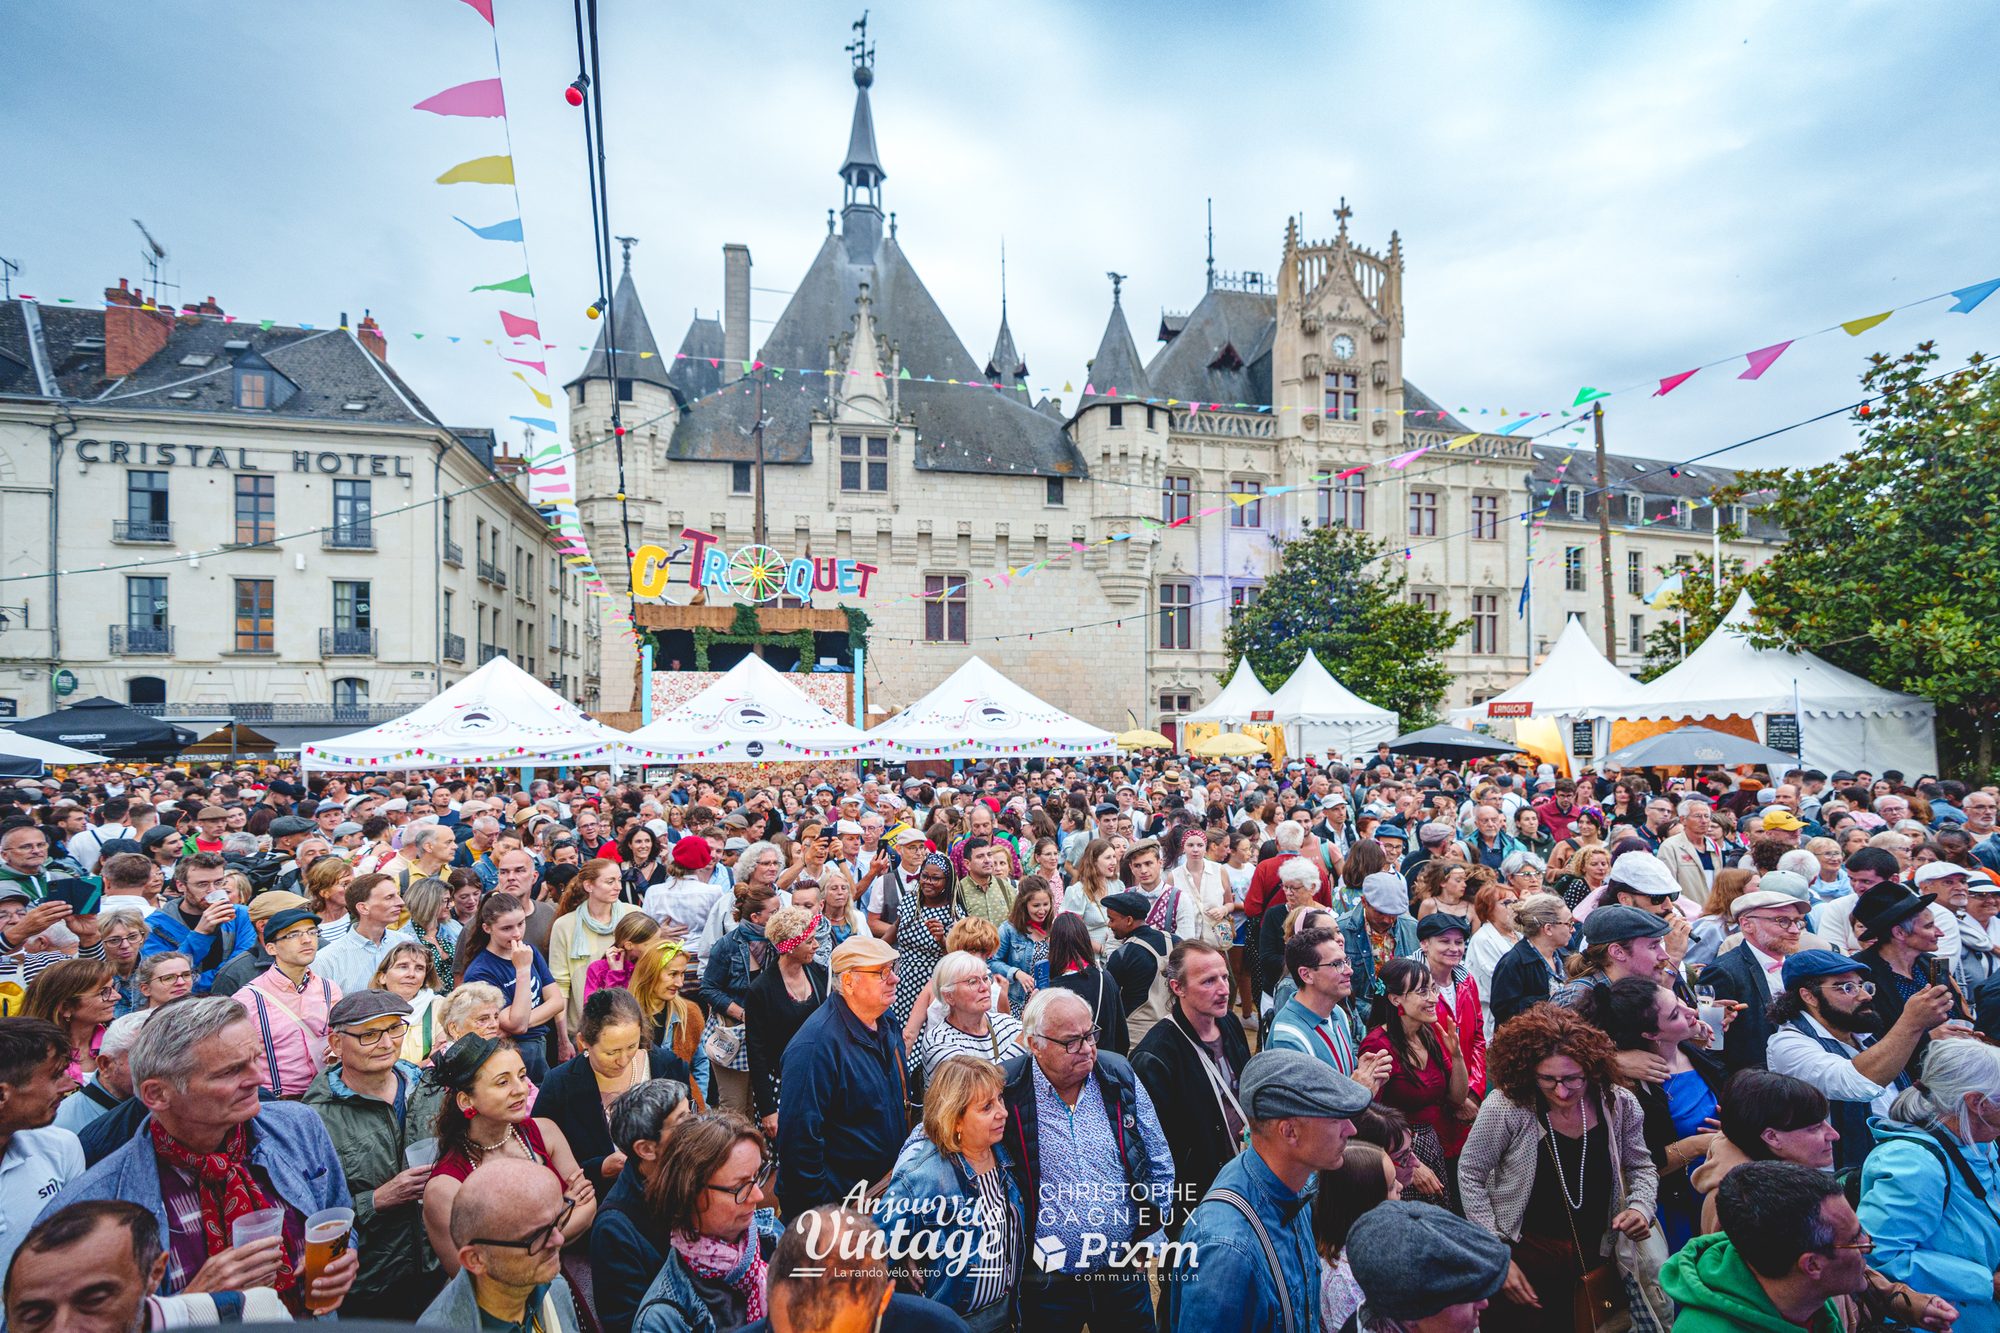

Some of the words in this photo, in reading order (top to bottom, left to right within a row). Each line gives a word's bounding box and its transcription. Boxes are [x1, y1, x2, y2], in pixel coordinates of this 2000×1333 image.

[75, 438, 258, 471] CRISTAL
[292, 449, 413, 478] HOTEL
[277, 752, 295, 760] BAR
